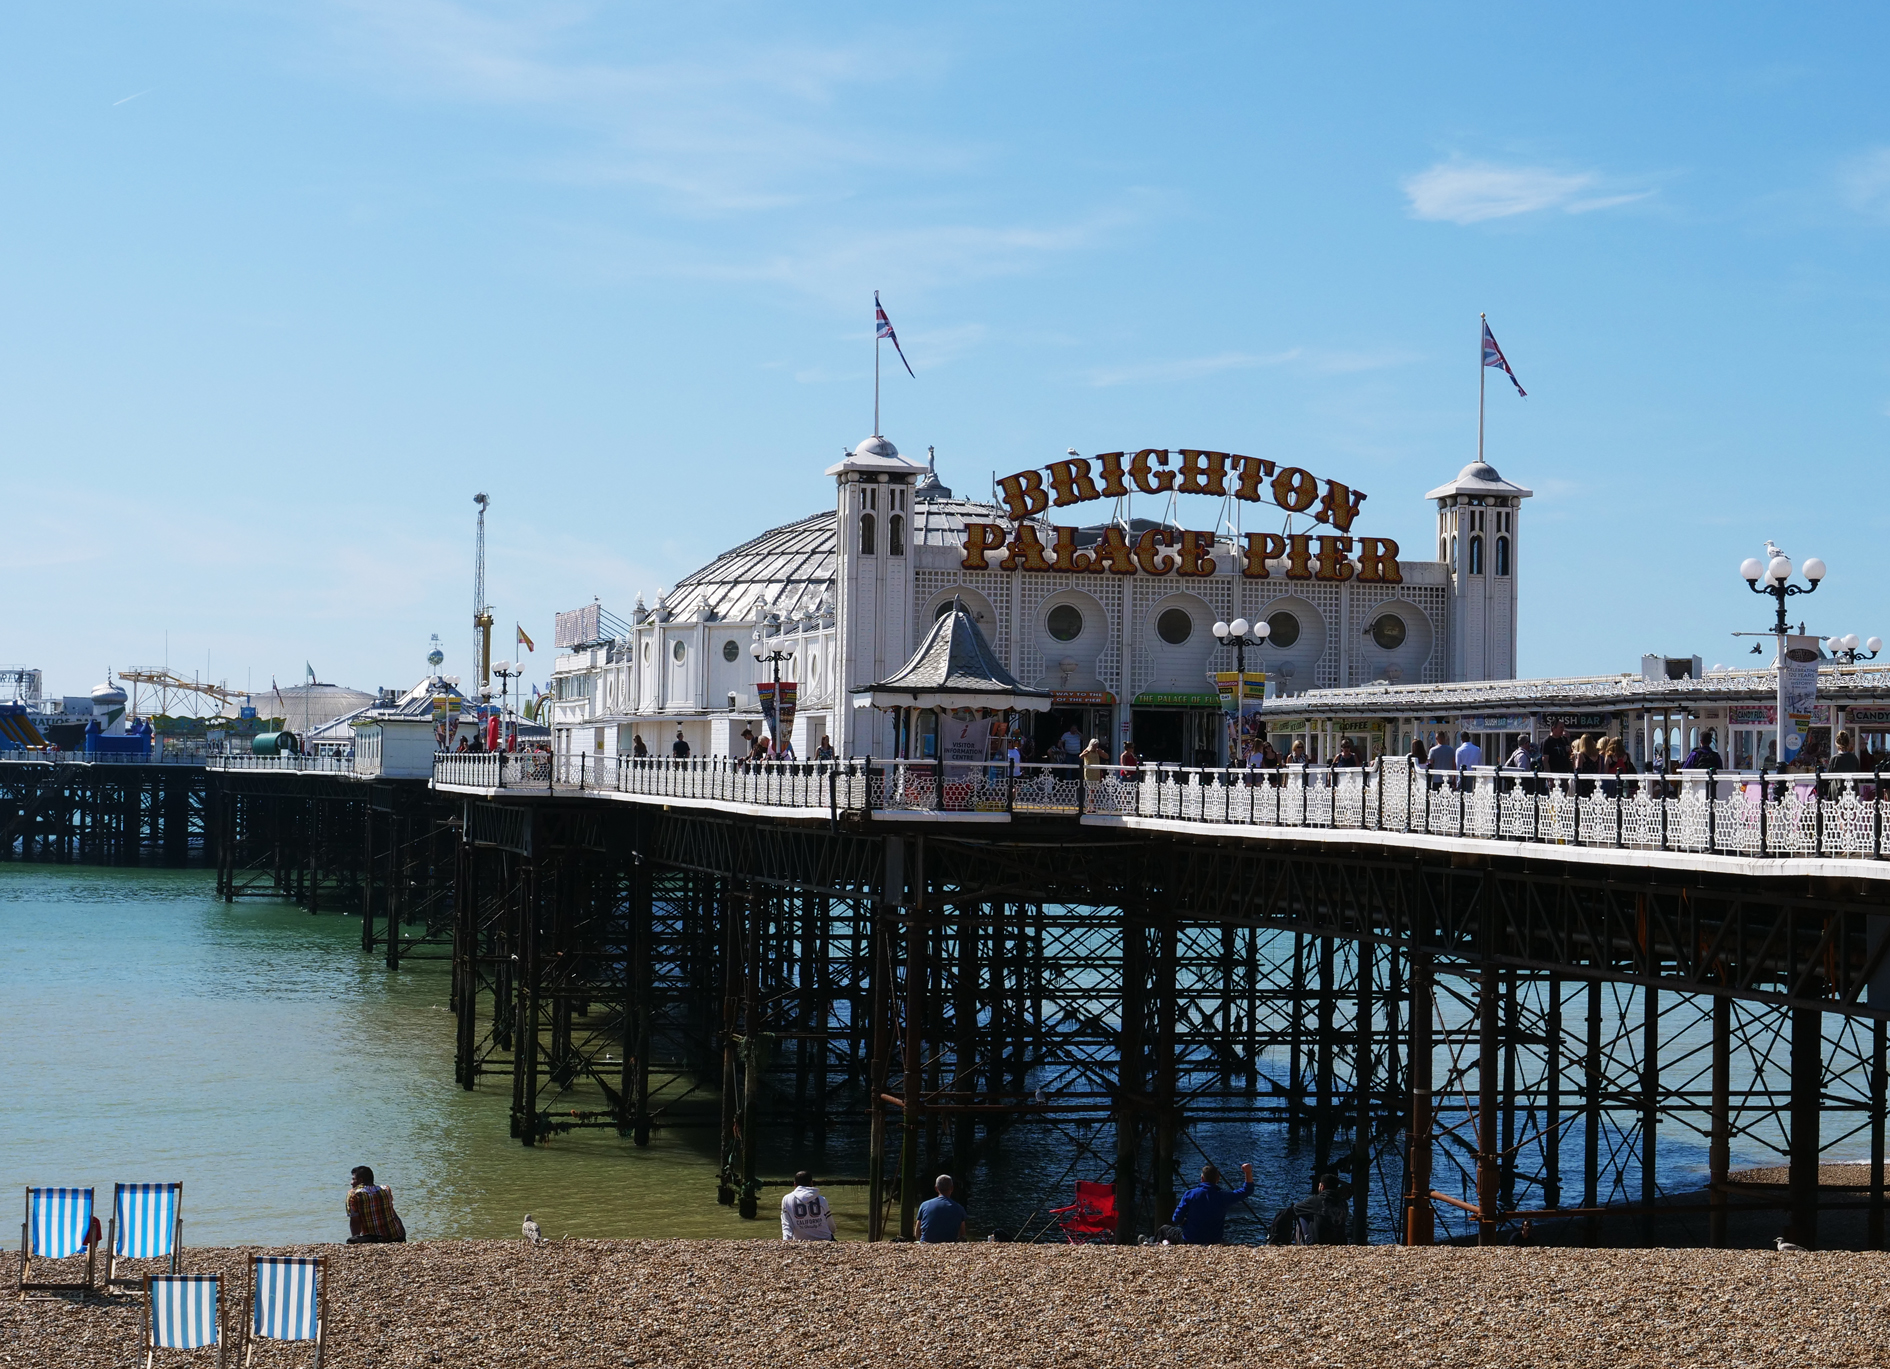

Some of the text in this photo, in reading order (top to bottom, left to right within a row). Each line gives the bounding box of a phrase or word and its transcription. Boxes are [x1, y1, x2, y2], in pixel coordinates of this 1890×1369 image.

[995, 448, 1368, 533] BRIGHTON
[961, 522, 1403, 584] PALACE PIER
[1139, 695, 1154, 703] THE
[1157, 695, 1188, 704] PALACE
[1191, 696, 1201, 704] OF
[1738, 709, 1767, 719] CANDY FLOSS
[1856, 711, 1890, 720] CANDY
[1484, 716, 1507, 726] SLUSH BAR
[1580, 716, 1600, 725] BAR
[1340, 721, 1368, 730] COFFEE
[944, 747, 983, 755] INFORMATION
